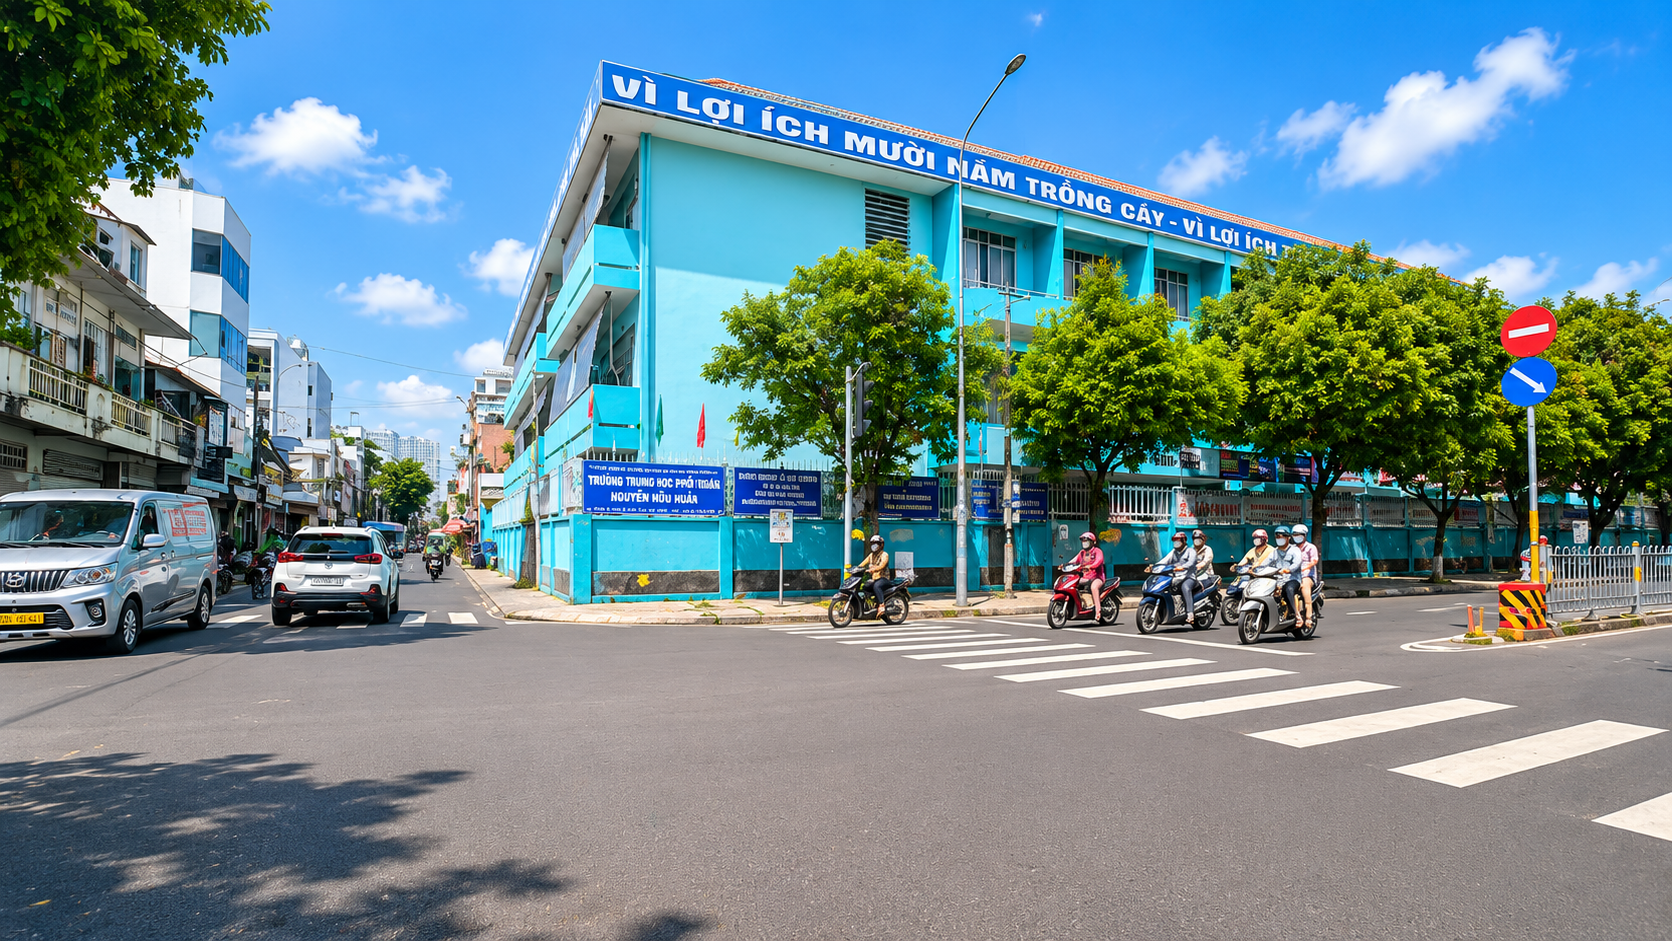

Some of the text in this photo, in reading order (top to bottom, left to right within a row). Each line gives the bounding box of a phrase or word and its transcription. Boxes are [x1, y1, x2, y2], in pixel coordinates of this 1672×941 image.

[611, 74, 657, 106] VÌ
[676, 90, 745, 125] LỢI
[760, 106, 830, 145] ÍCH
[844, 130, 936, 171] MƯỜI
[1025, 176, 1112, 214] TRỒNG
[1182, 216, 1204, 238] VÌ
[1210, 226, 1240, 248] LỢI
